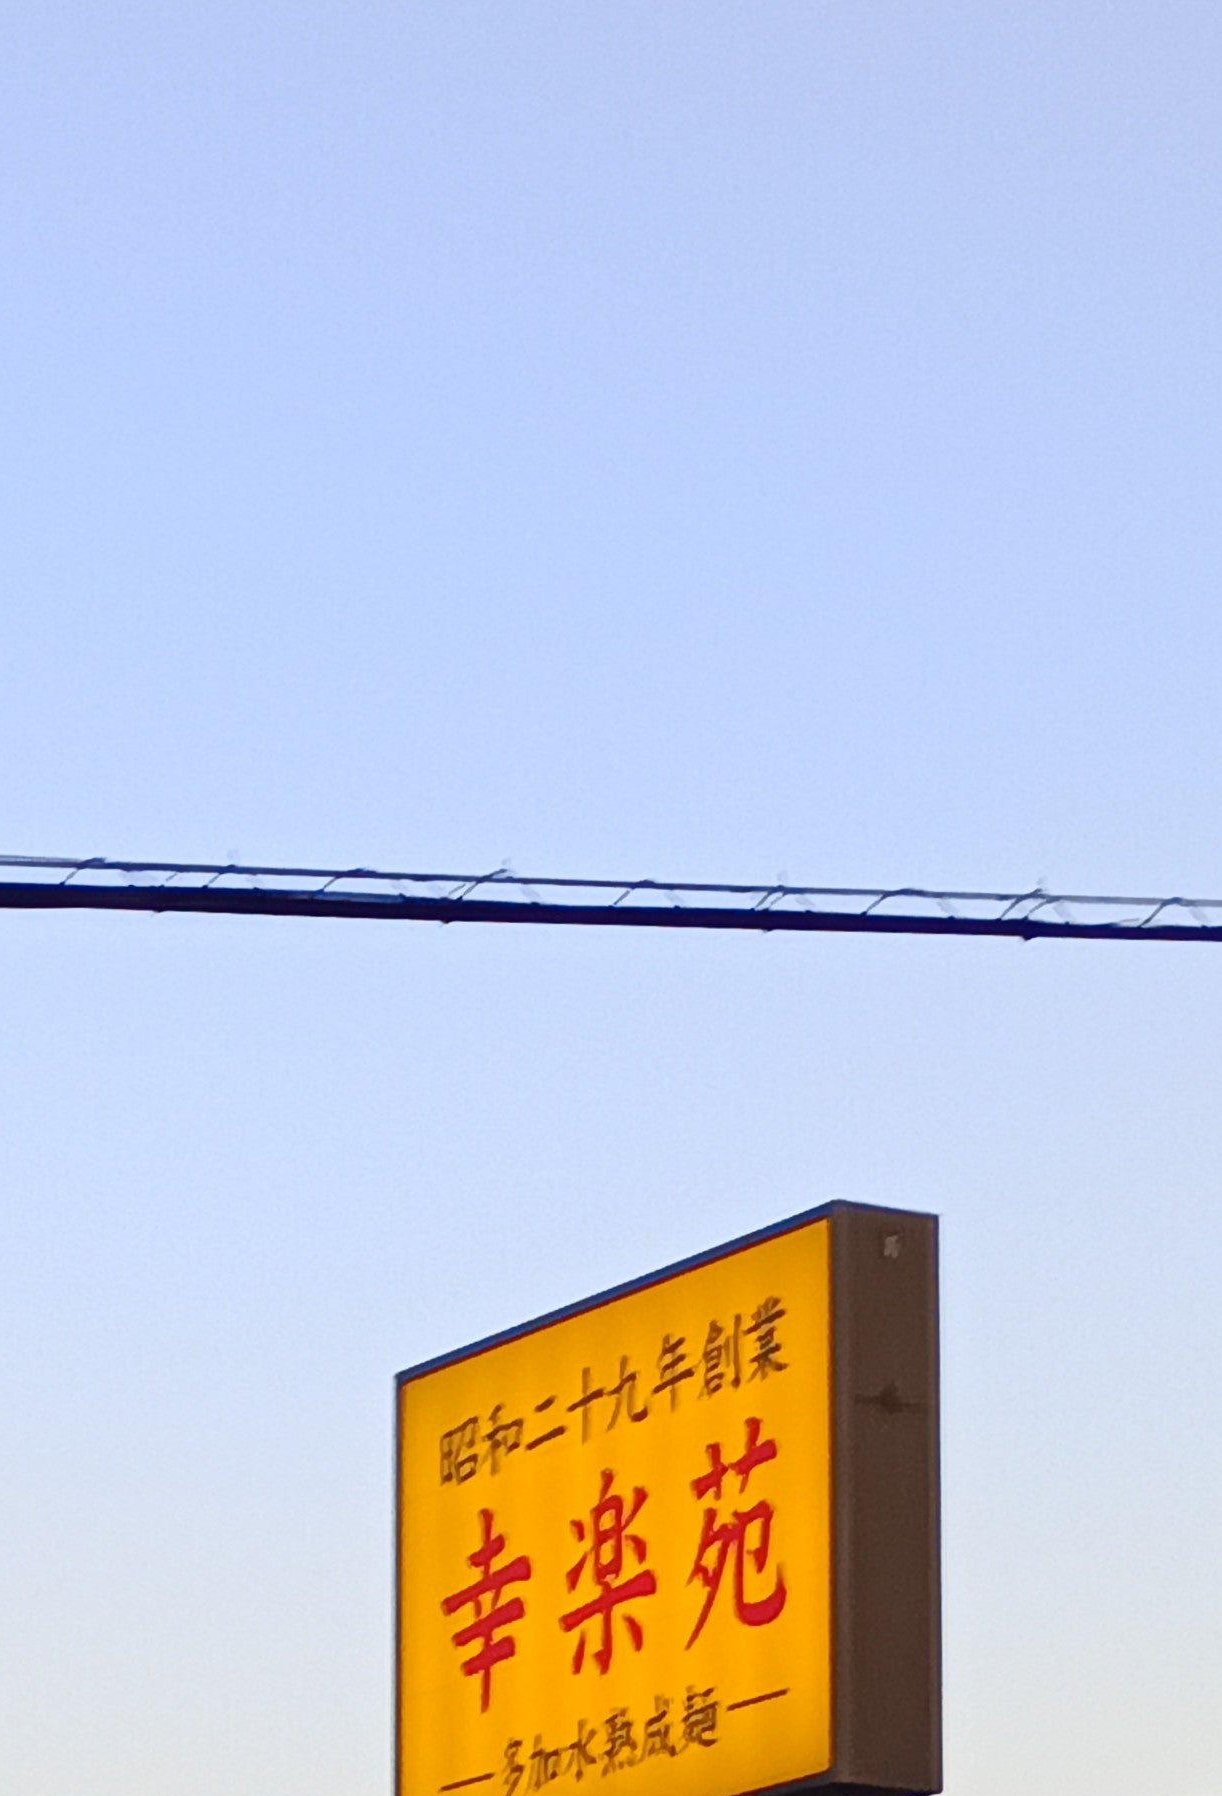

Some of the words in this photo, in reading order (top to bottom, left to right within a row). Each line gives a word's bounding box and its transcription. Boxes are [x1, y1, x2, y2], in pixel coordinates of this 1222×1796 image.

[440, 1296, 789, 1486] 昭和二十九年創業
[440, 1416, 788, 1712] 幸楽苑
